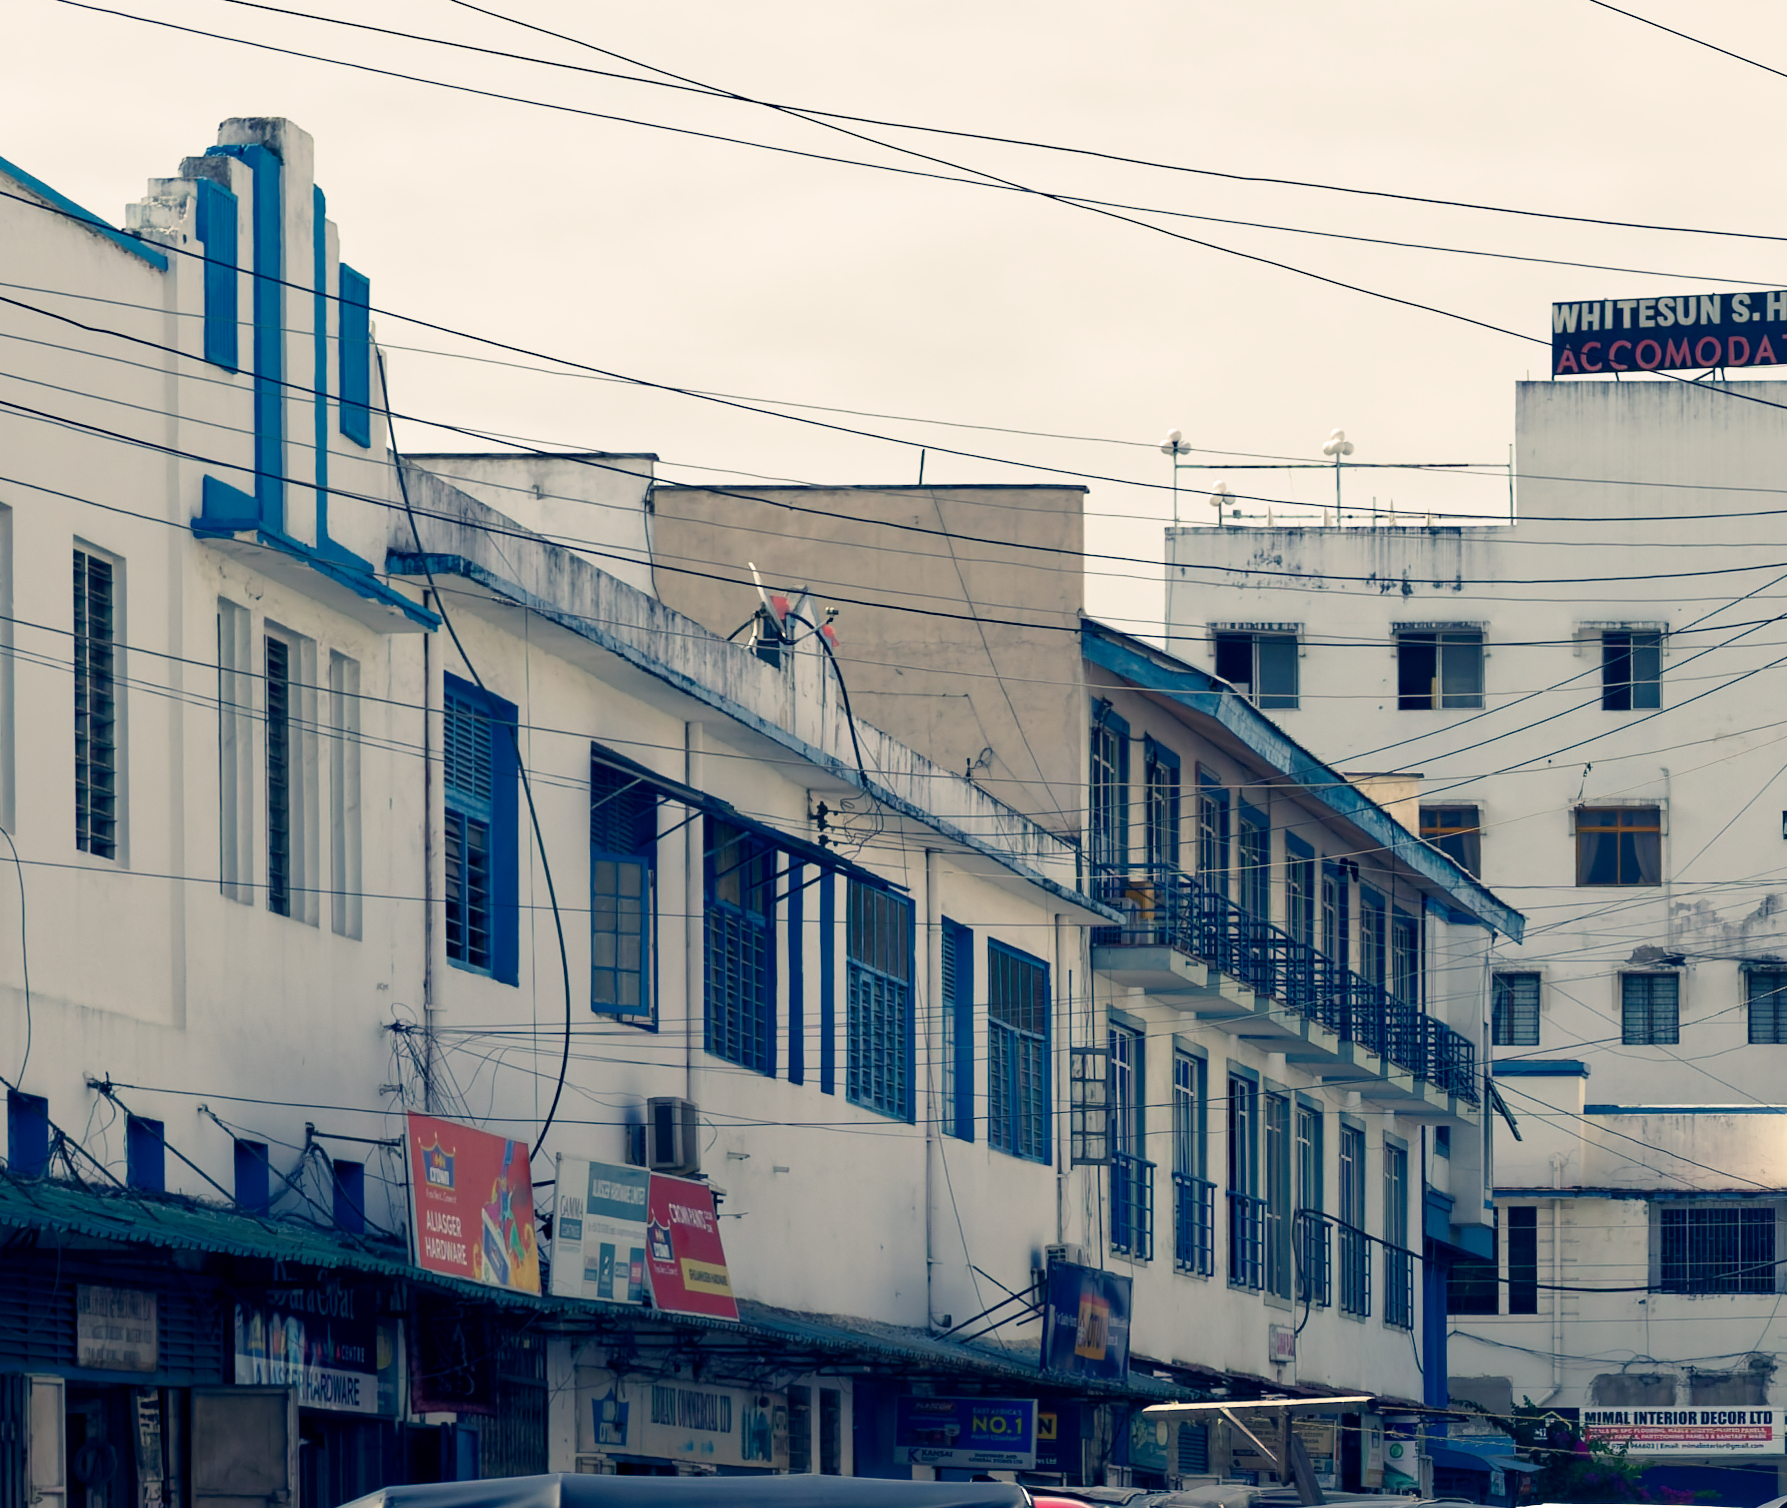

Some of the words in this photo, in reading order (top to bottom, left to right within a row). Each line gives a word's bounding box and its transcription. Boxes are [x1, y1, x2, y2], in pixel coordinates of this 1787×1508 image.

[1553, 295, 1721, 333] WHITESUN
[1731, 293, 1760, 323] S.
[426, 1209, 462, 1238] ALIASGER
[425, 1236, 468, 1266] HARDWARE
[307, 1374, 361, 1406] HARDWARE
[973, 1416, 1022, 1434] NO.1
[1584, 1412, 1628, 1425] MIMAL
[1633, 1411, 1698, 1425] INTERIOR
[1700, 1411, 1747, 1425] DECOR
[1750, 1411, 1773, 1424] LTD
